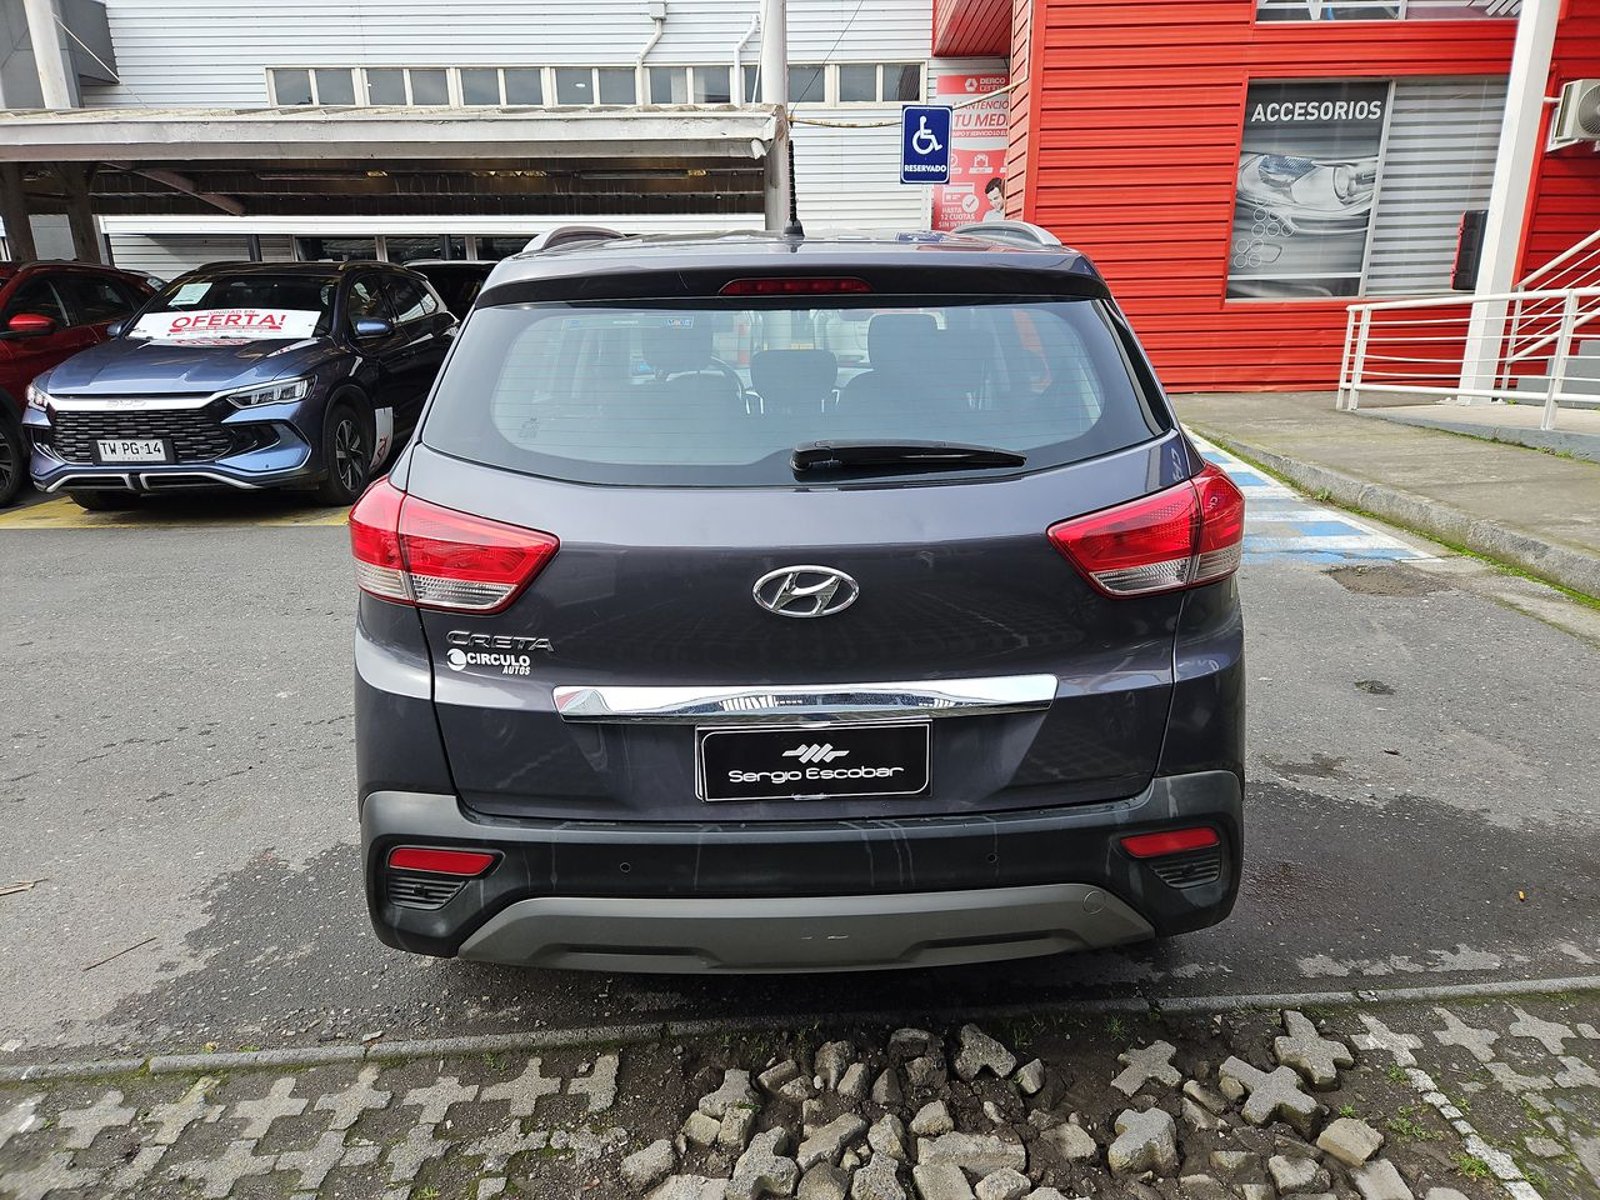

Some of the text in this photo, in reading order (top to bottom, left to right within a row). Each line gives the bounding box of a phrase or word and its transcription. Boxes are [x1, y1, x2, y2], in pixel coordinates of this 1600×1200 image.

[1251, 100, 1382, 122] ACCESORIOS
[954, 113, 1009, 127] TU MED
[904, 164, 948, 173] RESERVADO
[949, 213, 975, 221] CUOTAS
[171, 314, 287, 328] OFERTA!
[446, 630, 554, 652] CRETA
[466, 652, 531, 667] CIRCULO
[502, 665, 531, 675] AUTOS
[728, 765, 904, 784] Sergio Escobar
